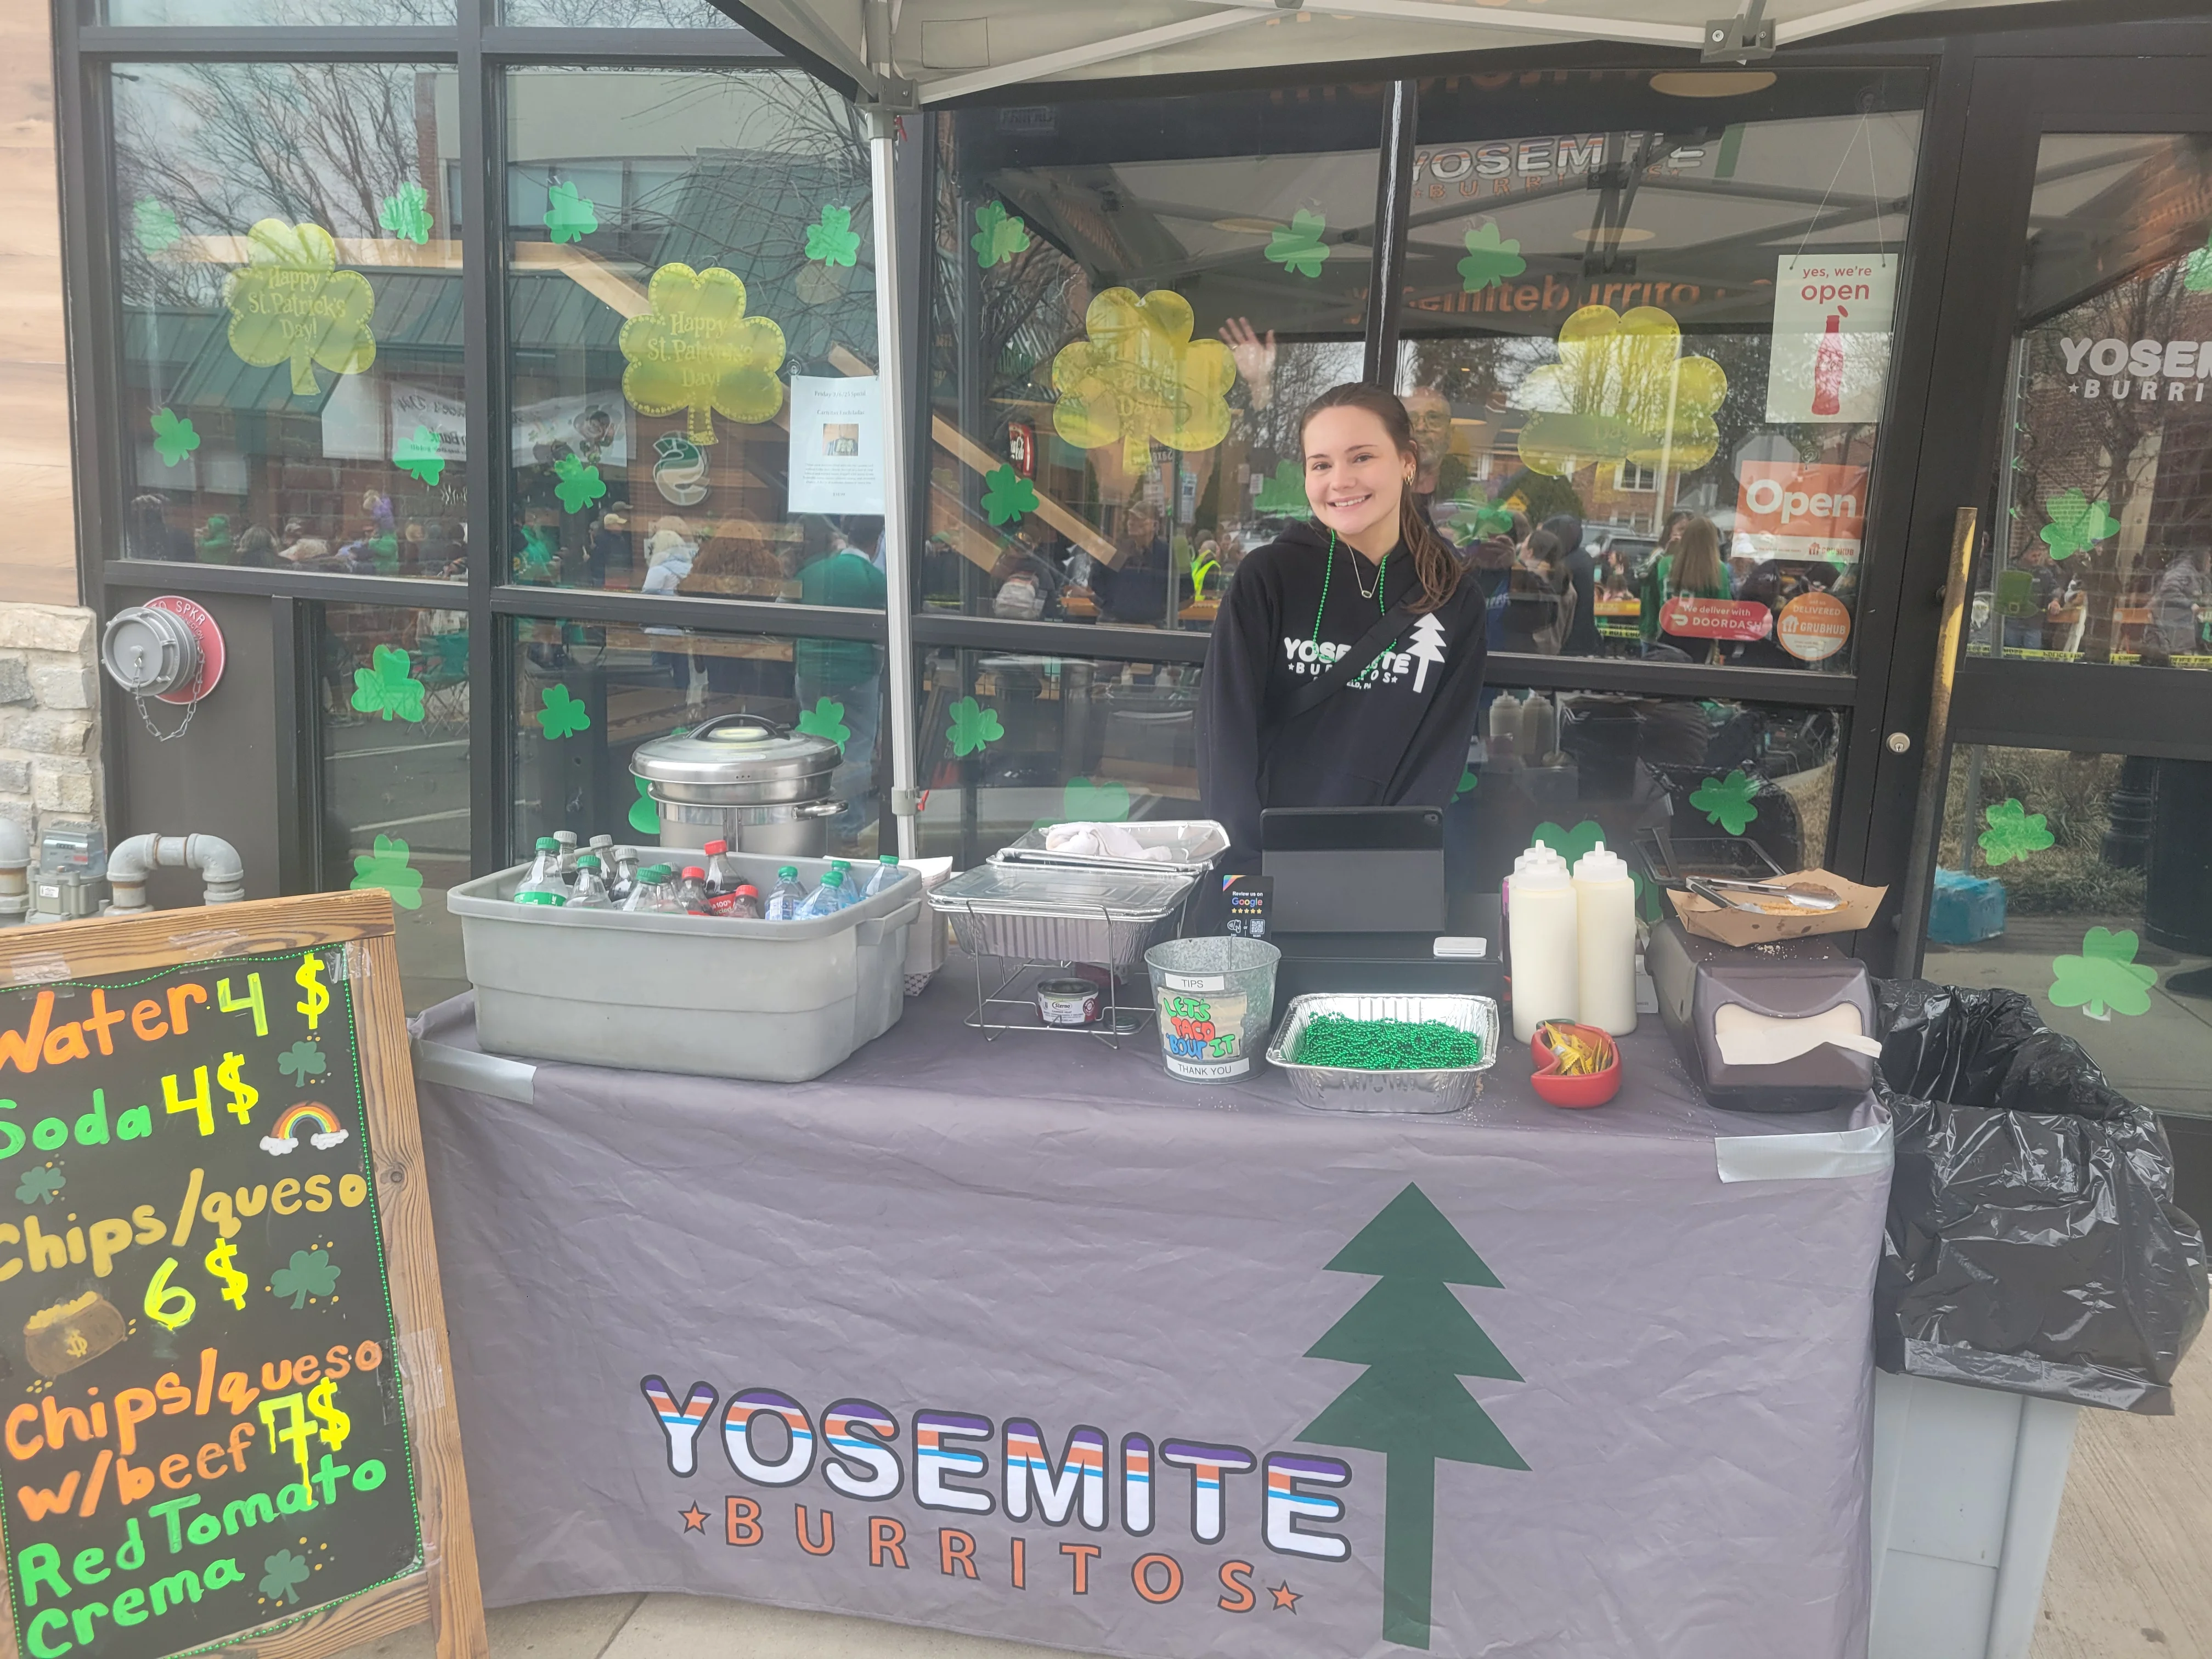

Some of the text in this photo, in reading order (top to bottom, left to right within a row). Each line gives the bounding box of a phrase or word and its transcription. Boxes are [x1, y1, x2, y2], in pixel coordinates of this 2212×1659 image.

[268, 265, 320, 292] Happy
[1803, 266, 1872, 279] yes, we're
[1801, 284, 1870, 304] open
[280, 316, 317, 341] Day!
[670, 311, 727, 338] Happy
[648, 336, 671, 362] St.
[681, 367, 720, 389] Day!
[1746, 479, 1857, 524] Open
[176, 601, 206, 626] SPKR
[1700, 605, 1729, 615] deliver
[1793, 605, 1841, 616] DELIVERED
[1692, 617, 1762, 630] DOORDASH
[1800, 622, 1846, 635] GRUBHUB
[1232, 897, 1263, 907] Google
[1181, 979, 1204, 988] TIPS
[1164, 996, 1211, 1022] LET'S
[1171, 1017, 1216, 1042] TACO
[1209, 1034, 1235, 1058] IT
[1178, 1063, 1232, 1075] THANK YOU
[0, 1088, 153, 1159] Soda
[17, 1422, 256, 1521] w/beef
[640, 1374, 1352, 1562] YOSEMITE
[17, 1454, 387, 1606] Red Tomato
[724, 1493, 1259, 1614] BURRITOS
[26, 1557, 246, 1659] Crema
